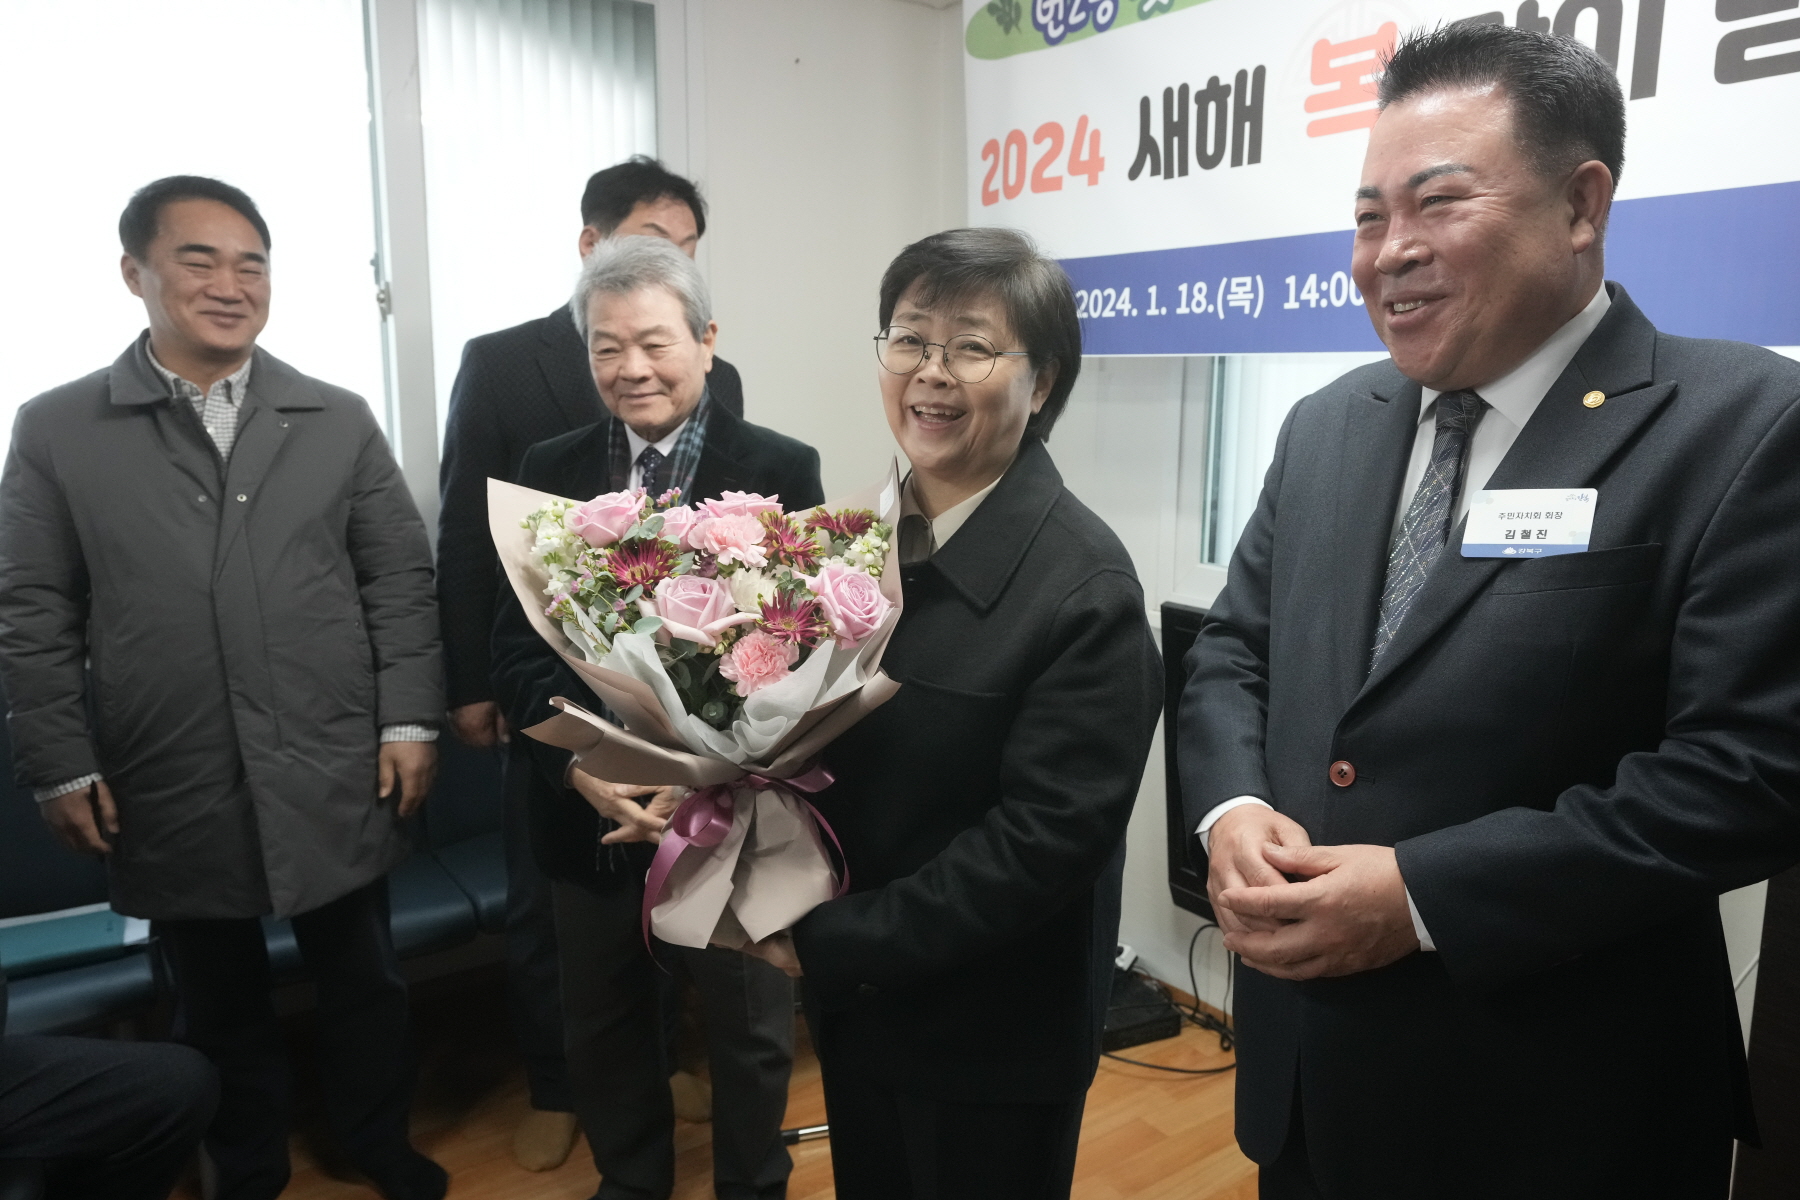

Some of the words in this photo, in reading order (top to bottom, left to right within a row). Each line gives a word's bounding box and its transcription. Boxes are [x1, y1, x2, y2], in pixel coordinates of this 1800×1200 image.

[981, 114, 1105, 206] 2024
[1128, 64, 1266, 181] 새해
[1304, 21, 1398, 138] 복
[1075, 287, 1138, 319] 2024.
[1146, 285, 1167, 316] 1.
[1176, 274, 1264, 320] 18.(목)
[1498, 511, 1542, 520] 주민자치회
[1545, 511, 1563, 520] 회장
